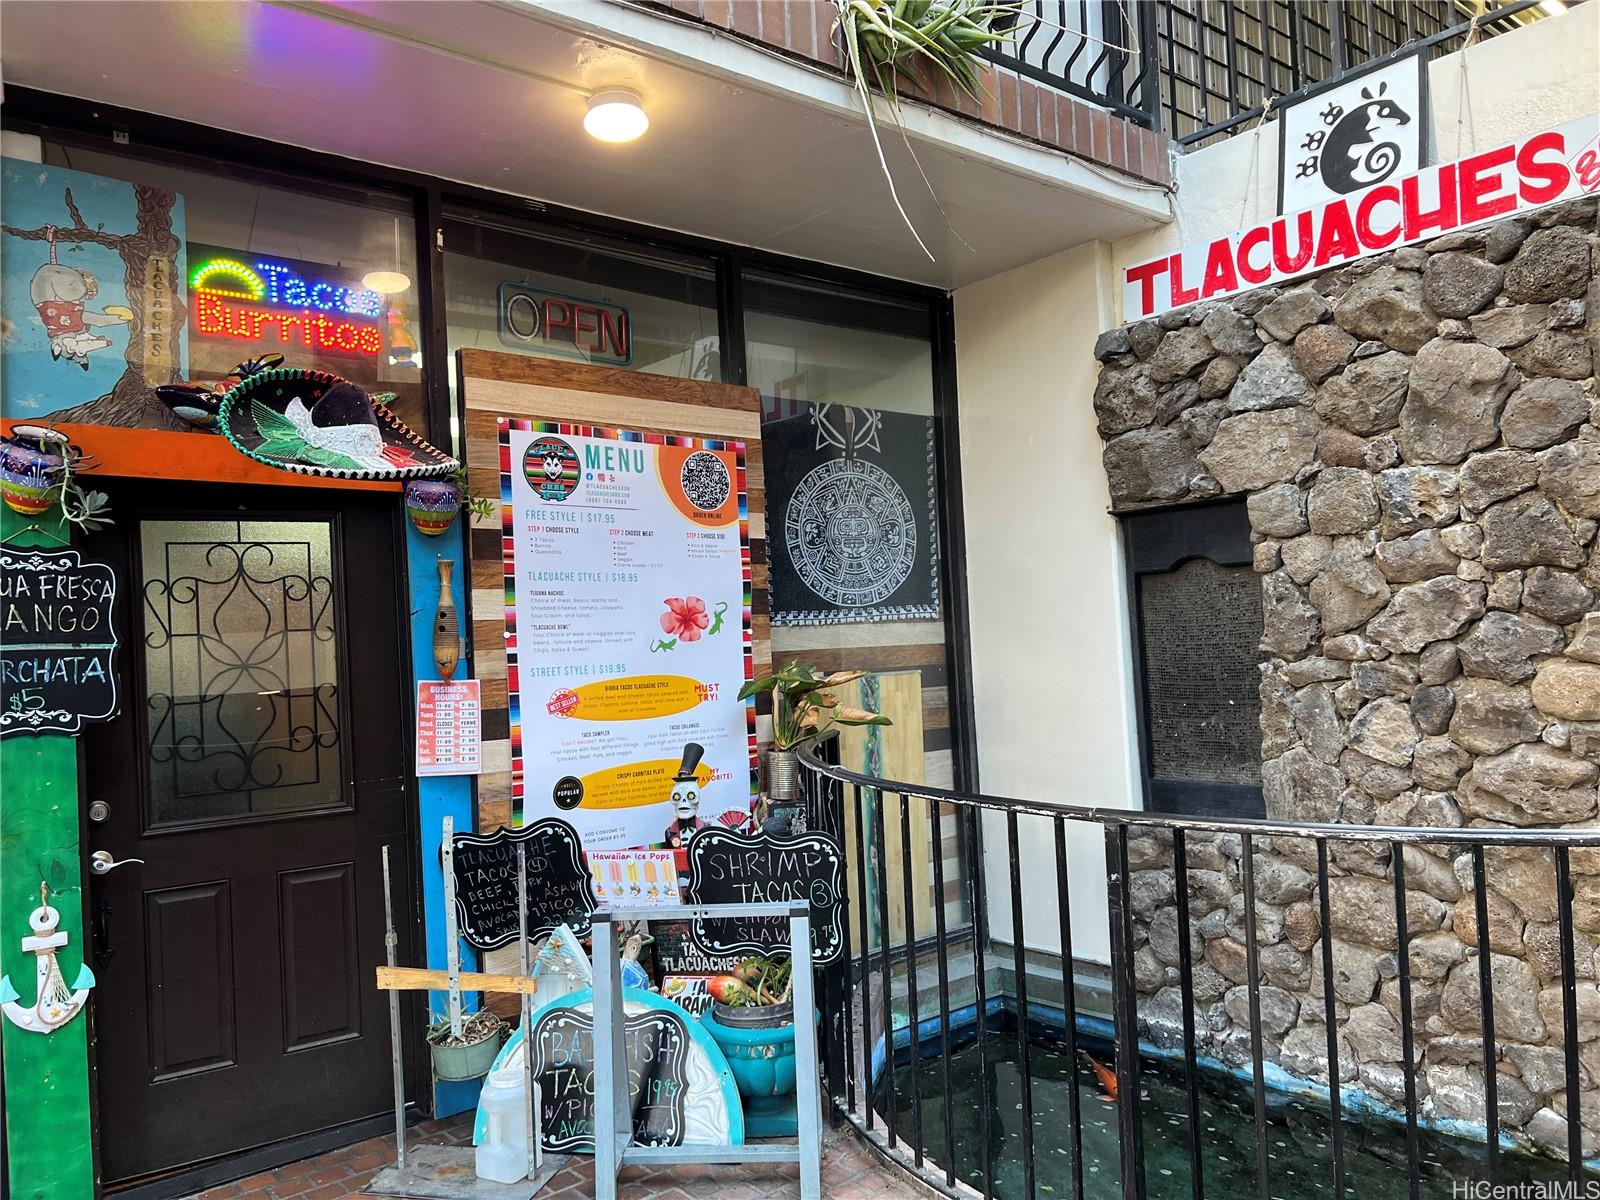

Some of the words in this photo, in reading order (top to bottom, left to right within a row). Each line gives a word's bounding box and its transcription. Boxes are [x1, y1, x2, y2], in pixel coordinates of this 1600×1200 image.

[1126, 132, 1570, 315] TLACUACHES
[257, 263, 381, 317] Tacos
[198, 292, 381, 353] Burritos
[507, 294, 627, 357] OPEN
[585, 444, 645, 473] MENU
[526, 510, 546, 520] FREE
[550, 511, 576, 522] STYLE
[588, 512, 615, 524] $17.95
[0, 574, 30, 598] UA
[38, 574, 115, 603] FRESCA
[528, 571, 574, 581] TLACUACHE
[578, 572, 601, 582] STYLE
[612, 573, 639, 582] $18.95
[0, 603, 99, 632] ANGO
[0, 656, 106, 685] RCHATA
[531, 667, 560, 678] STREET
[564, 665, 588, 675] STYLE
[600, 664, 626, 674] $19.95
[10, 687, 45, 711] $5
[694, 684, 719, 693] MUST
[557, 789, 579, 797] POPULAR
[457, 836, 556, 869] TLACUAHE
[650, 853, 670, 861] Pops
[709, 851, 821, 880] SHRIMP
[732, 879, 804, 903] TACOS
[546, 1068, 641, 1099] TACS
[566, 1098, 595, 1119] PIC
